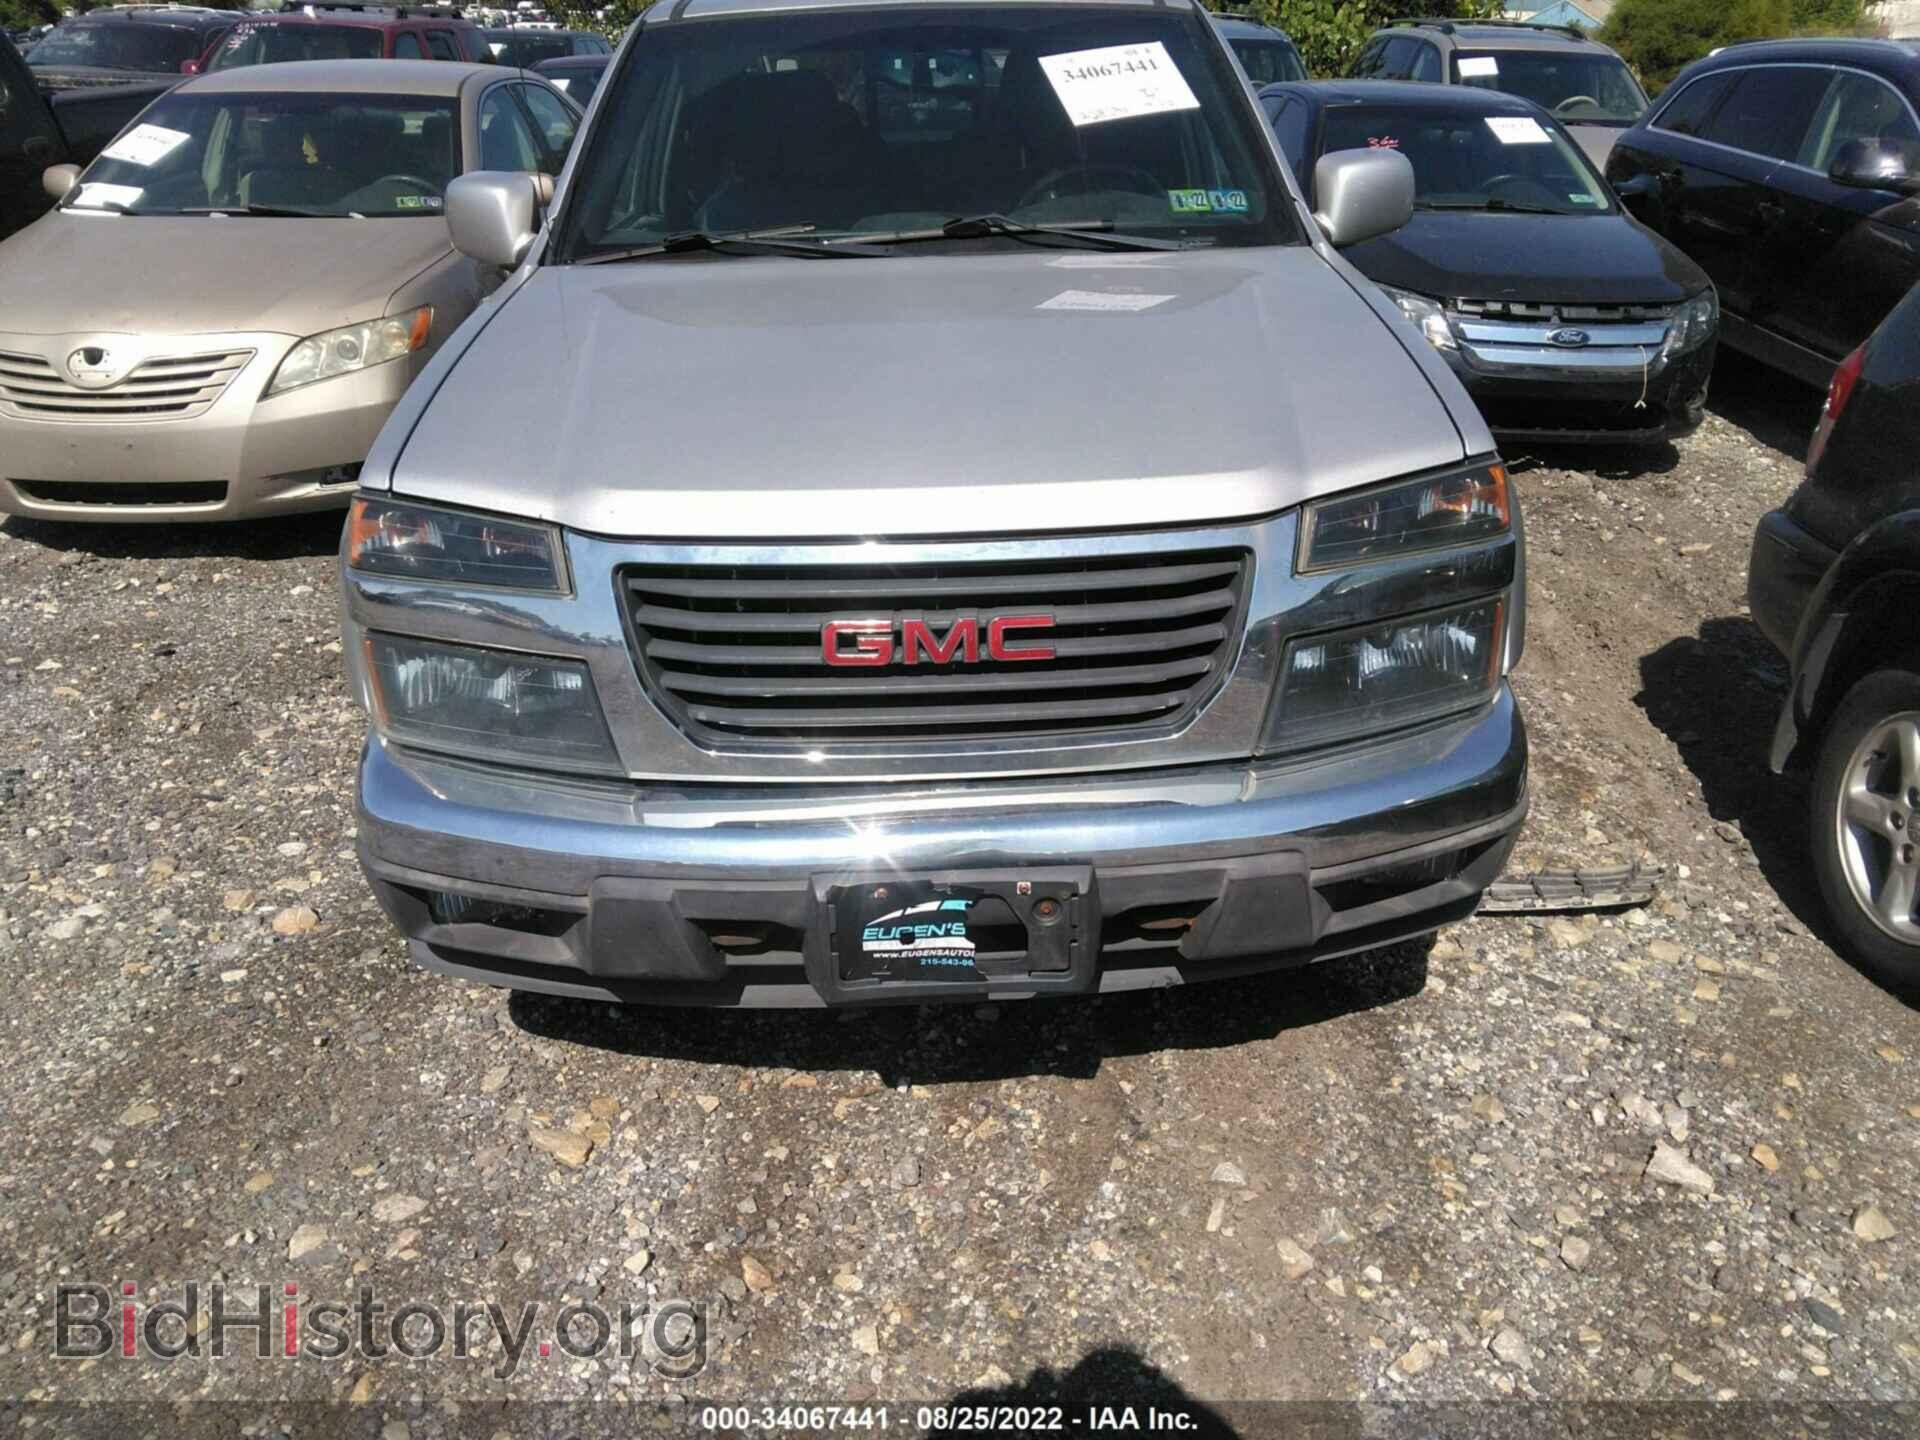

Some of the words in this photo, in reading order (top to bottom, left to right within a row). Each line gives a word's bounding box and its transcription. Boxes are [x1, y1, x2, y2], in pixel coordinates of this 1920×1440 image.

[1063, 58, 1159, 83] 34067441
[1558, 329, 1584, 344] Ford
[822, 613, 1056, 667] GMC
